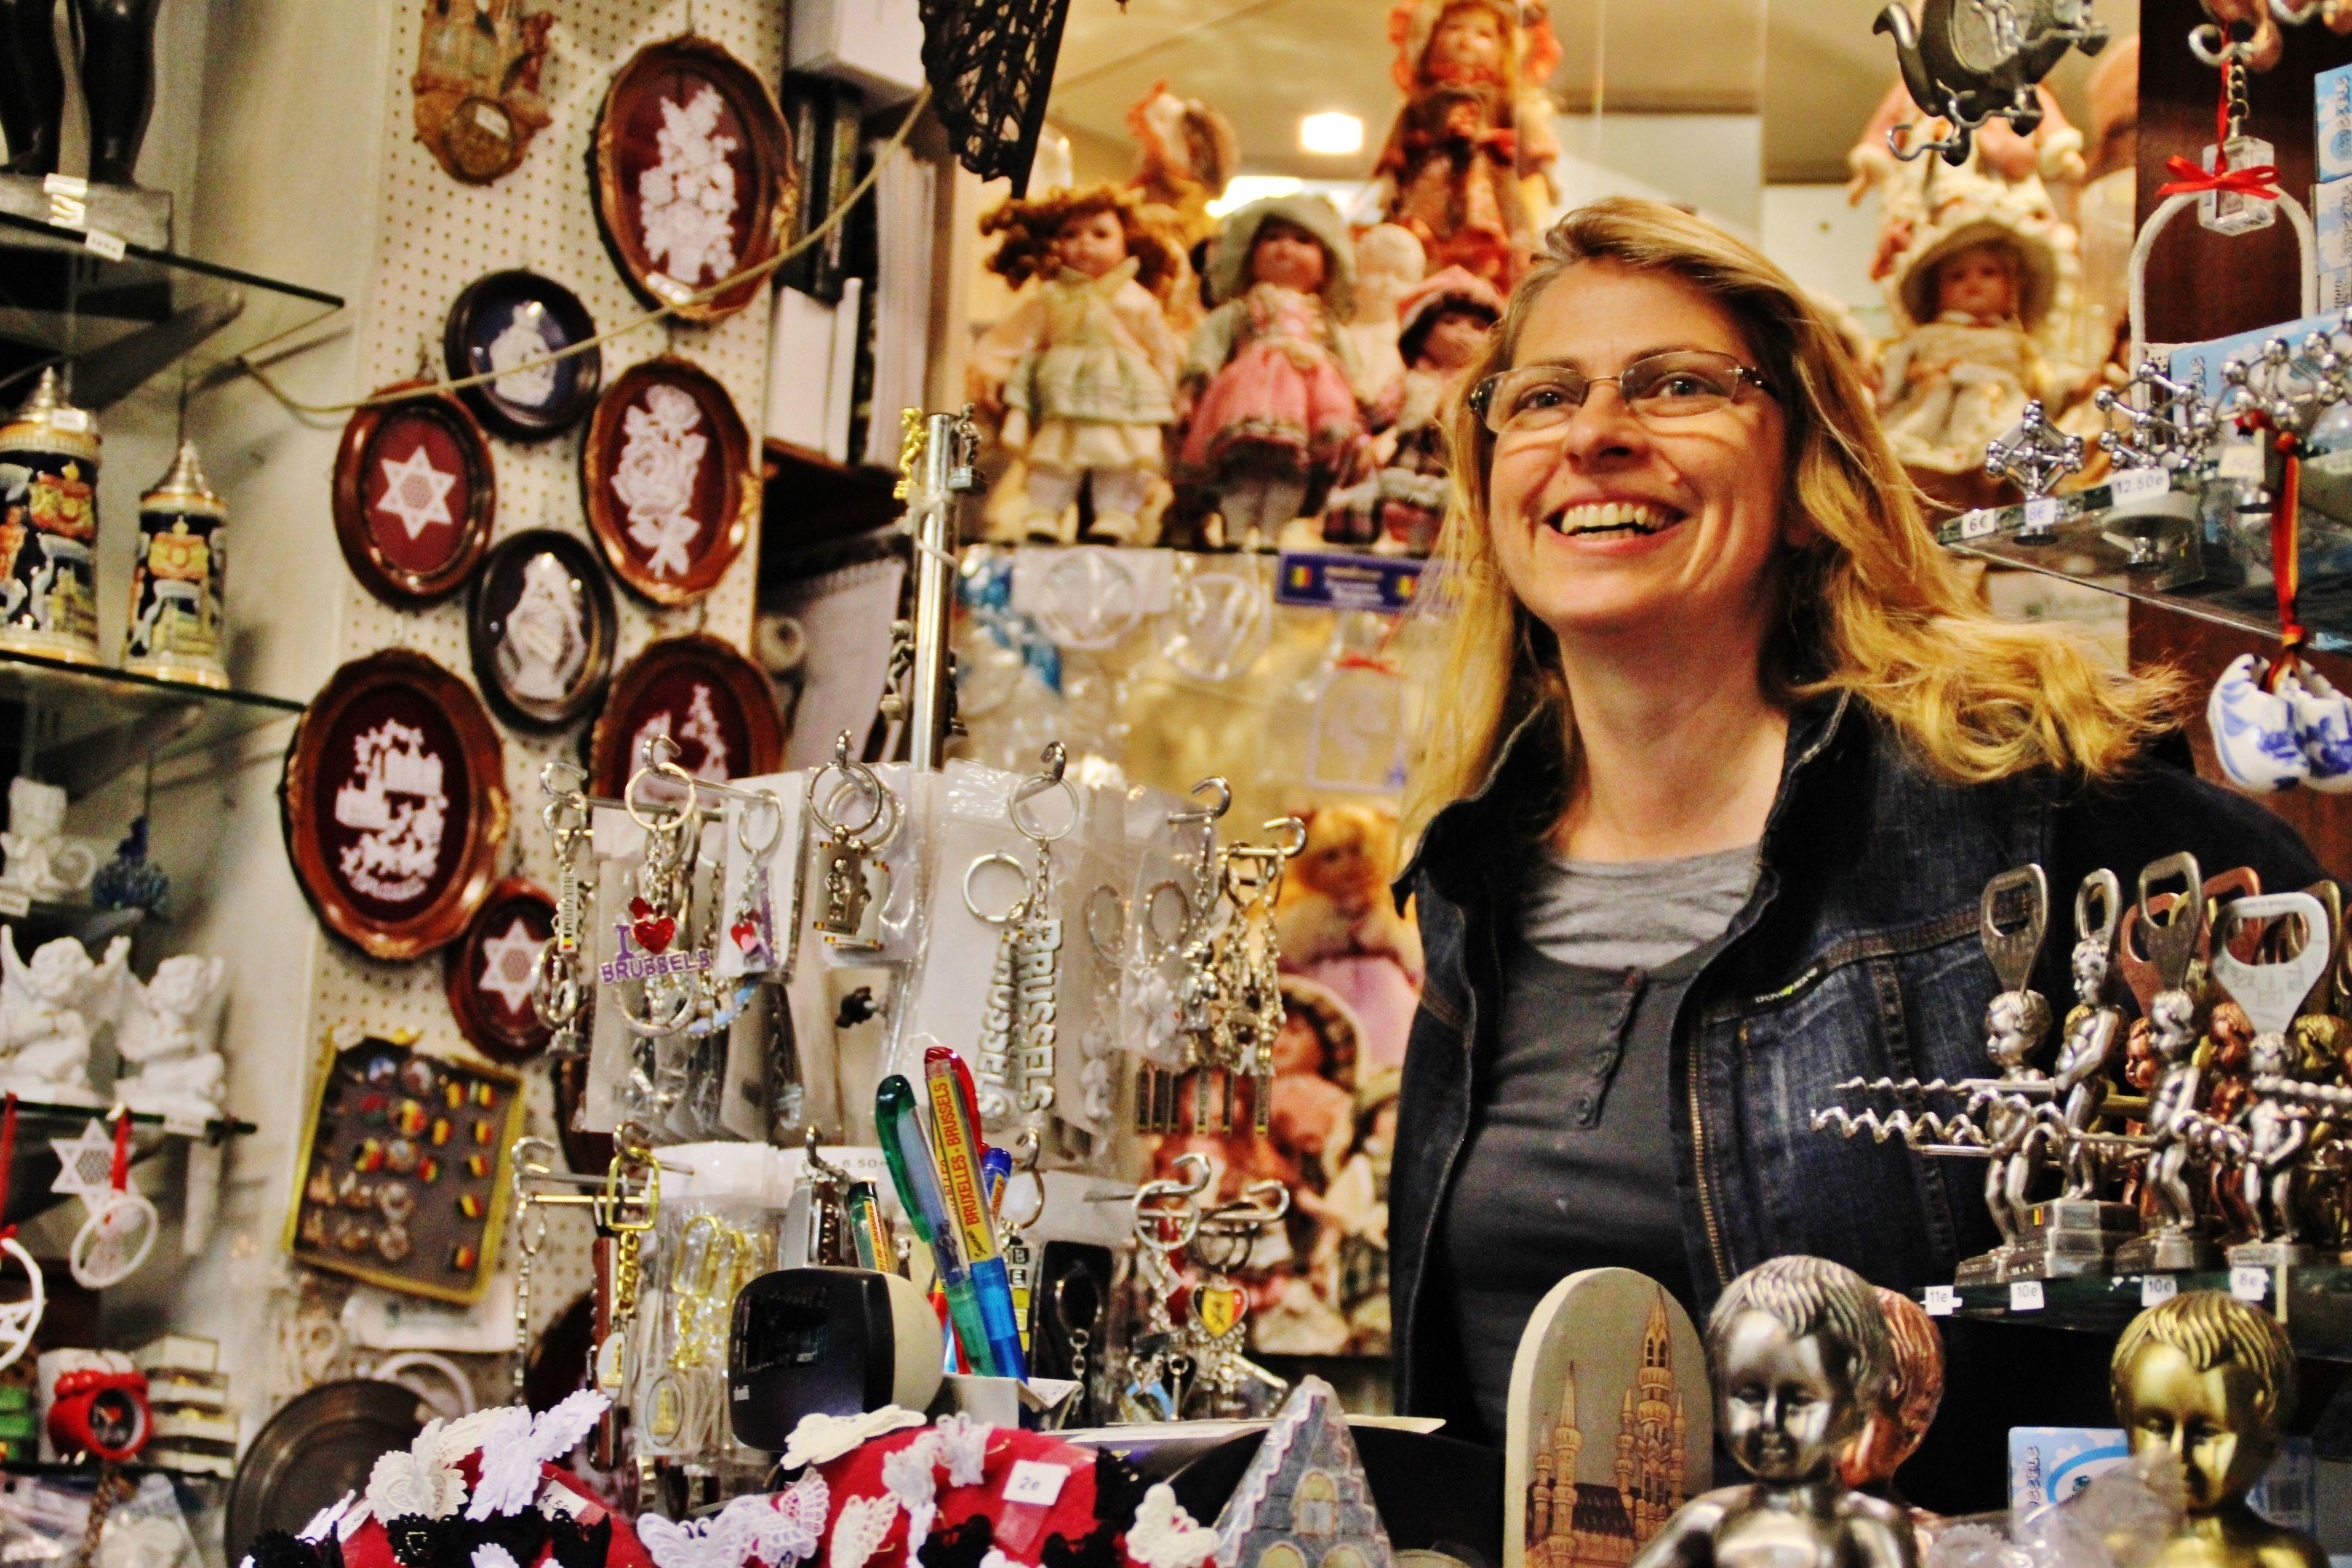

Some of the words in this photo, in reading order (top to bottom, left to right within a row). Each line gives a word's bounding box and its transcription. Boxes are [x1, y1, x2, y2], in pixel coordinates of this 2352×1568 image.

[1969, 514, 1987, 531] 6€
[616, 925, 635, 960] I
[601, 949, 711, 983] BRUSSELS
[976, 929, 1012, 1118] USSELS
[1017, 919, 1061, 1112] BRUSSELS
[934, 1082, 962, 1147] BRUSSELS
[951, 1155, 980, 1226] BRUXELLES
[1931, 1291, 1948, 1303] 11e
[2018, 1284, 2038, 1298] 10e
[1019, 1476, 1039, 1490] 2e
